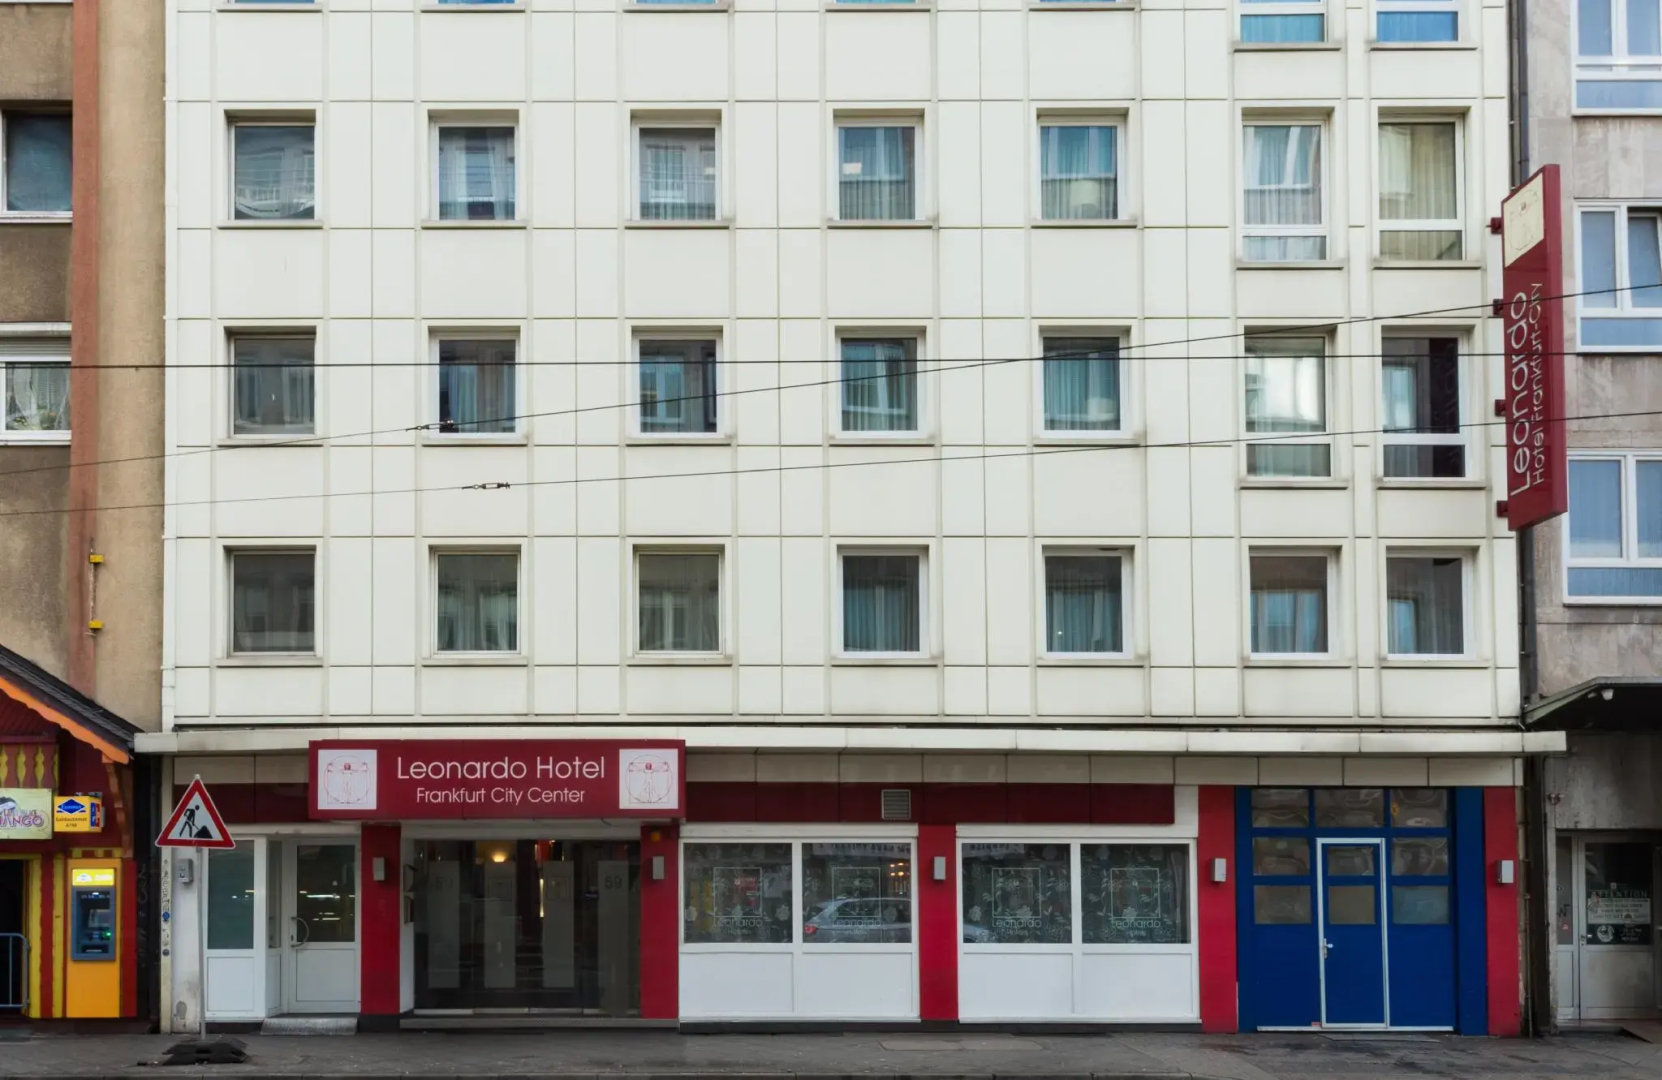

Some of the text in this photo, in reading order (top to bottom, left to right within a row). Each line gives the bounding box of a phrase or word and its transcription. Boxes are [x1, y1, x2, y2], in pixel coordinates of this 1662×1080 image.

[1507, 292, 1530, 496] Leonardo
[1532, 427, 1545, 485] Hotel
[397, 756, 605, 779] Leonardo Hotel
[416, 787, 585, 806] Frankfurt City Center
[0, 815, 44, 827] ANGO
[604, 876, 623, 889] 59
[992, 917, 1042, 927] Leonardo
